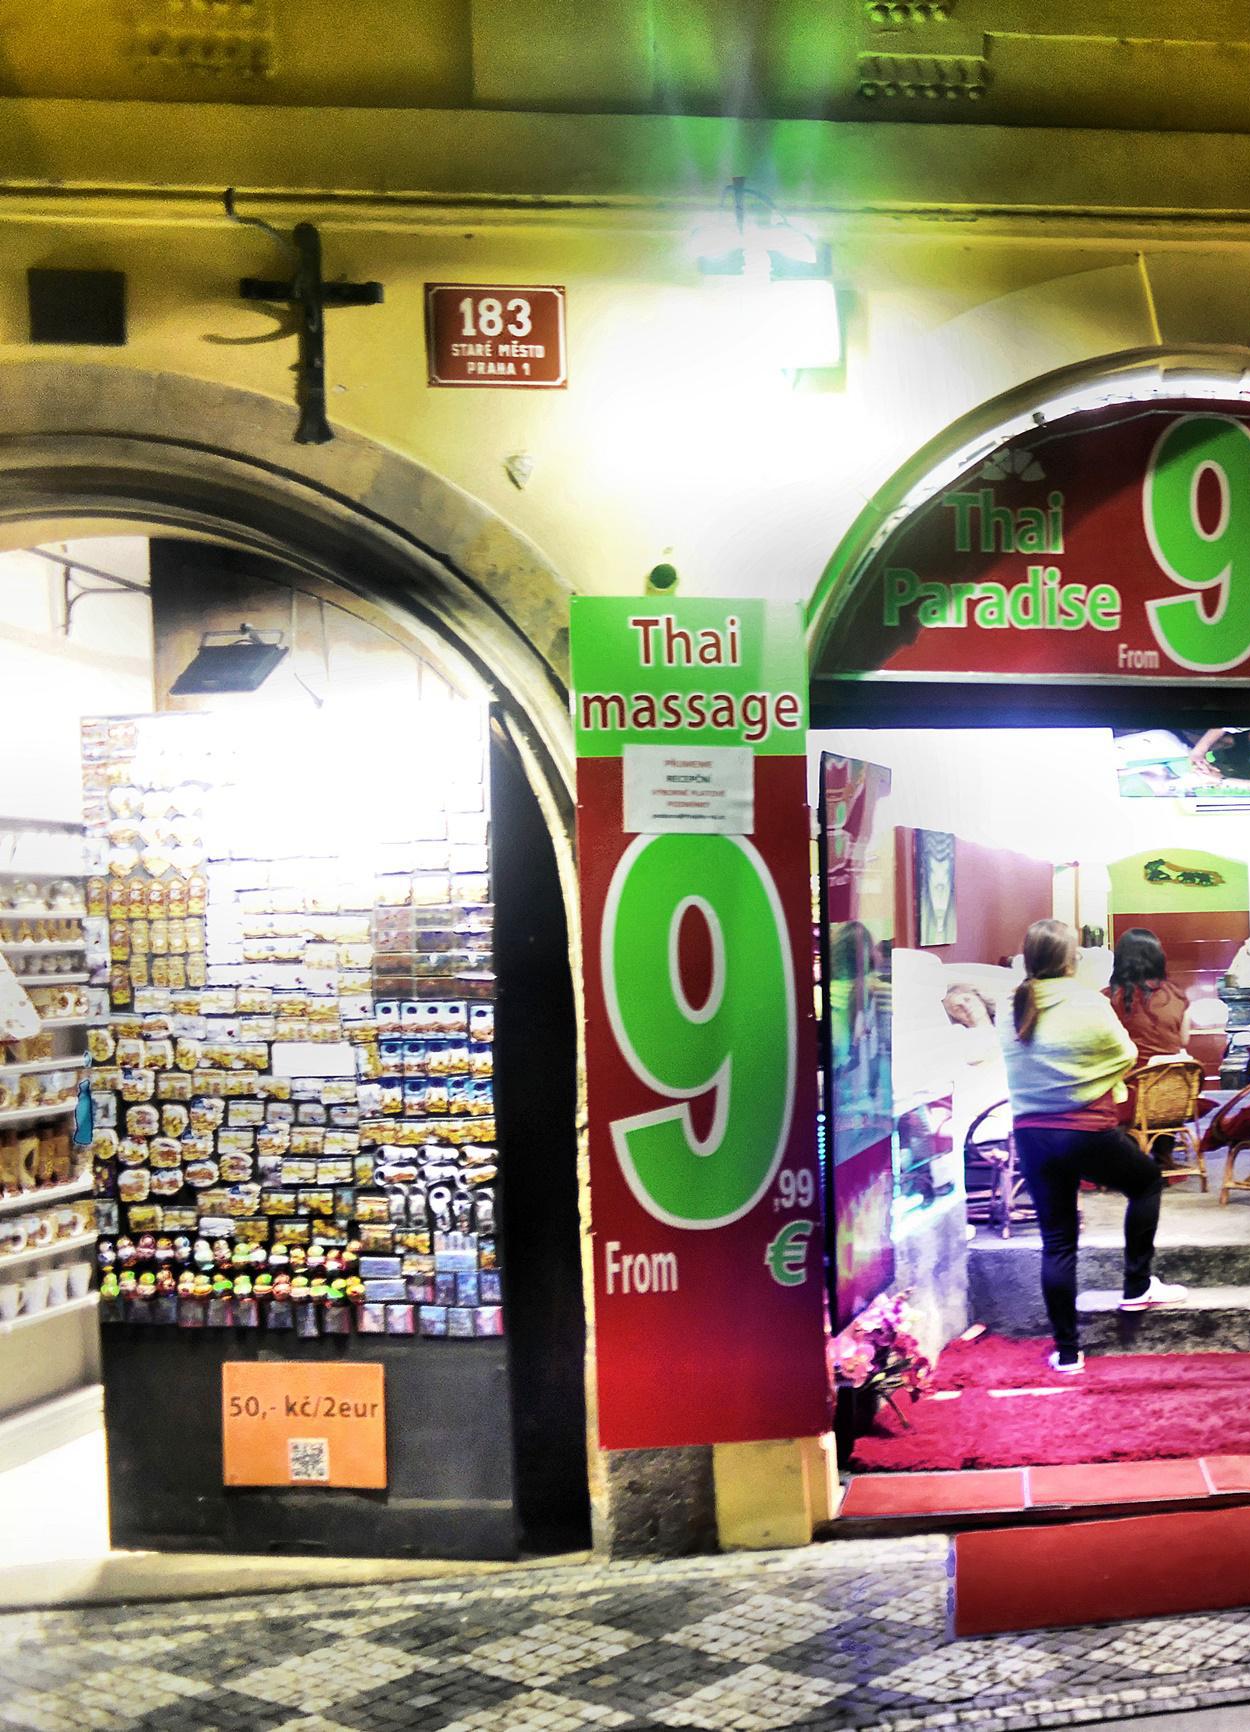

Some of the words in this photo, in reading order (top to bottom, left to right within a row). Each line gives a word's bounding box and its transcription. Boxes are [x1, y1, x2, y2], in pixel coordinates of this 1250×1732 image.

[459, 297, 533, 337] 183
[451, 340, 493, 357] STARÉ
[498, 340, 545, 358] MĚSTO
[467, 361, 517, 375] PRAHA
[521, 362, 532, 376] 1
[943, 488, 1064, 554] Thai
[883, 565, 1122, 632] Paradise
[630, 616, 742, 667] Thai
[1118, 643, 1160, 669] From
[580, 692, 801, 744] massage
[601, 830, 797, 1231] 9
[605, 1241, 678, 1294] From
